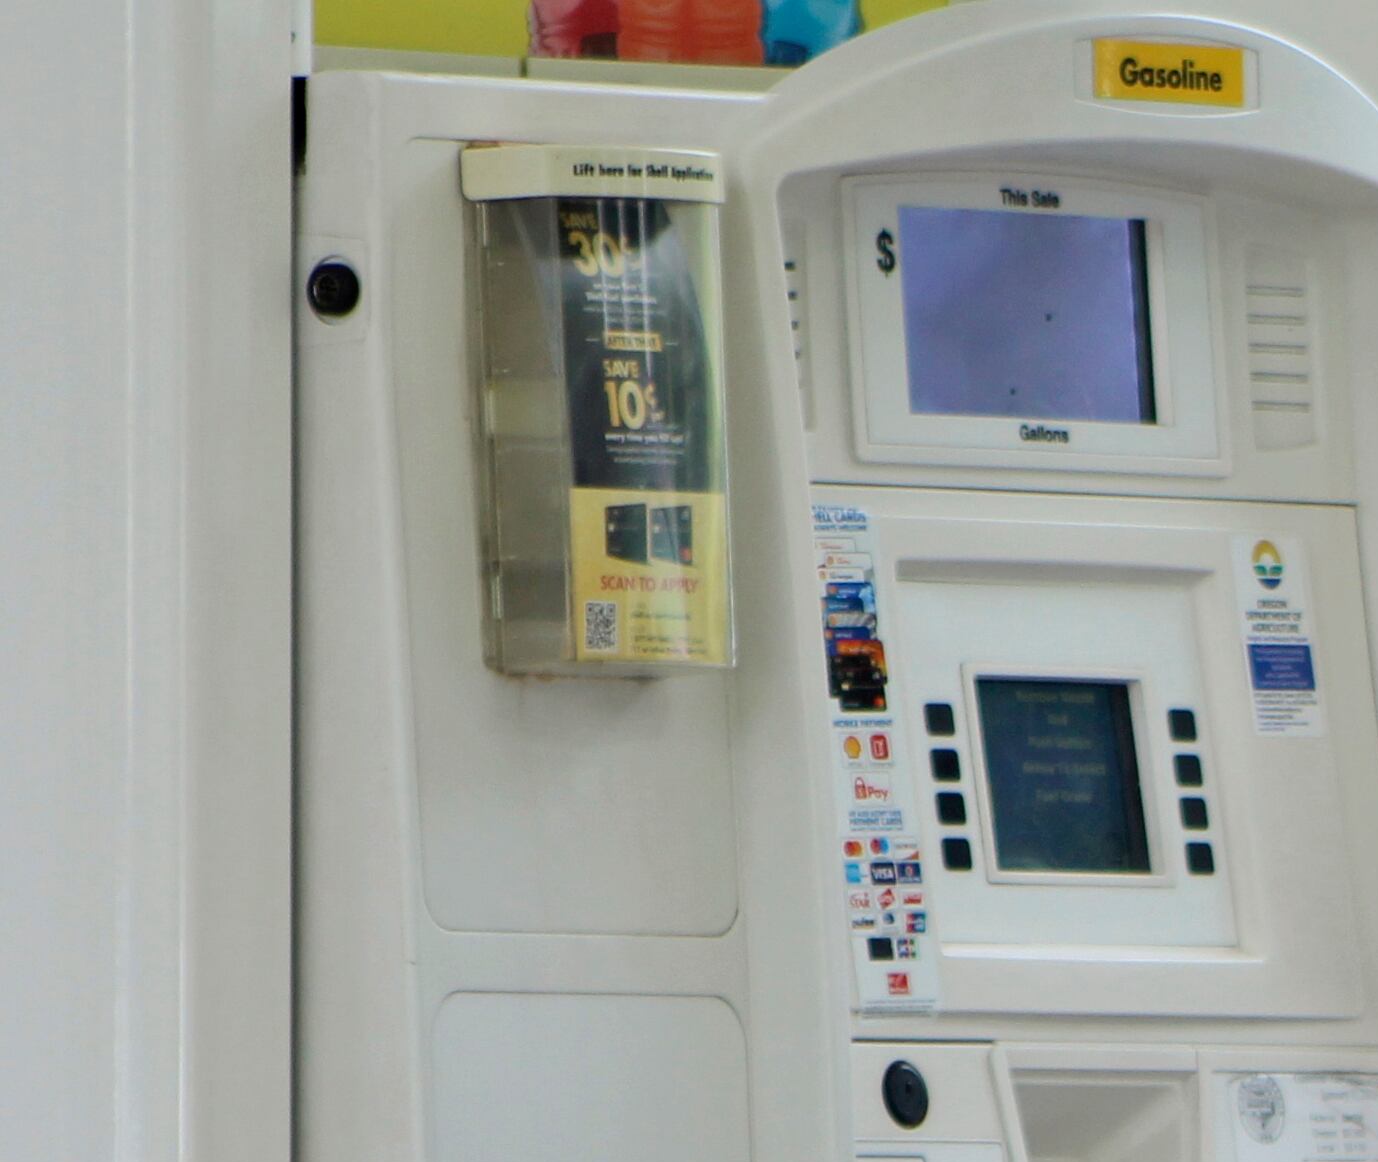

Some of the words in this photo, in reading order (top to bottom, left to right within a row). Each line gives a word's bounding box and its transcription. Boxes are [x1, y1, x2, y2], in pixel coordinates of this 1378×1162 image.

[1118, 57, 1223, 92] Gasoline
[572, 163, 595, 176] Lift
[598, 163, 624, 177] here
[627, 164, 642, 177] for
[645, 164, 669, 178] Shell
[671, 166, 714, 182] Application
[1000, 188, 1027, 207] This
[1030, 191, 1061, 210] Sale
[875, 229, 896, 278] $
[602, 359, 640, 379] SAVE
[1019, 424, 1071, 444] Gallons
[600, 575, 636, 592] SCAN
[640, 577, 656, 592] TO
[660, 577, 699, 594] APPLY
[871, 867, 895, 881] VISA
